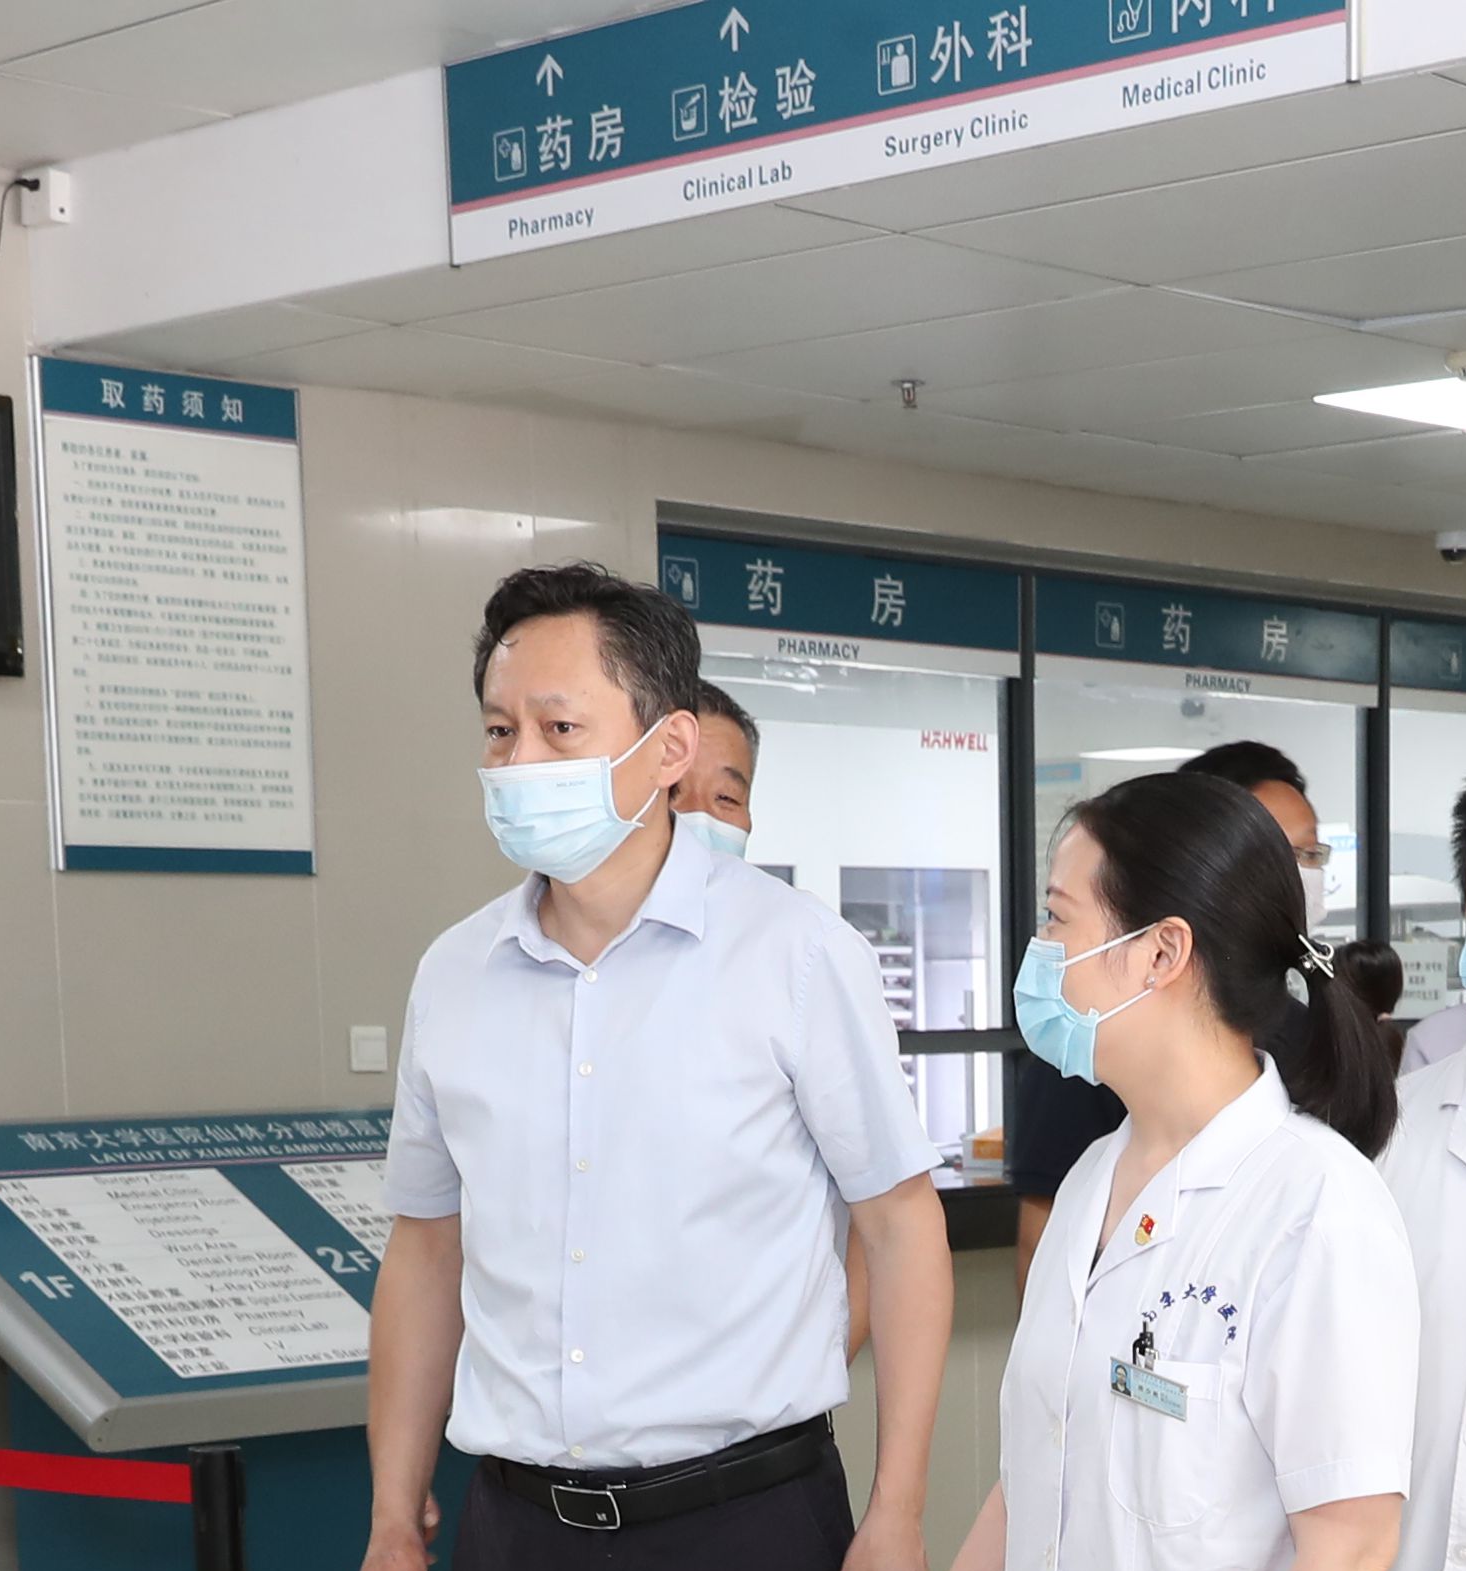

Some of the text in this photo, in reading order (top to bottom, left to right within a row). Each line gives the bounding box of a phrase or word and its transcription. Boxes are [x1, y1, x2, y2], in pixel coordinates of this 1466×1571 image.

[1171, 0, 1275, 34] 内
[930, 5, 1033, 83] 外科
[718, 59, 817, 134] 检验
[1122, 59, 1267, 109] Medical Clinic
[536, 104, 625, 174] 药房
[884, 110, 1029, 157] Surgery Clinic
[682, 160, 793, 201] Clinical Lab
[508, 207, 594, 239] Pharmacy
[101, 378, 243, 423] 取药须知
[745, 558, 907, 627] 药房
[778, 638, 860, 660] PHARMACY
[1161, 603, 1289, 663] 药房
[1185, 673, 1252, 693] PHARMACY
[90, 1150, 166, 1164] LAYOUT
[168, 1149, 194, 1161] OF
[197, 1144, 271, 1159] XIANLIN
[316, 1246, 377, 1275] 2F
[19, 1271, 75, 1300] 1F
[233, 1307, 306, 1322] Pharmacy
[248, 1320, 329, 1335] Clinical Lab
